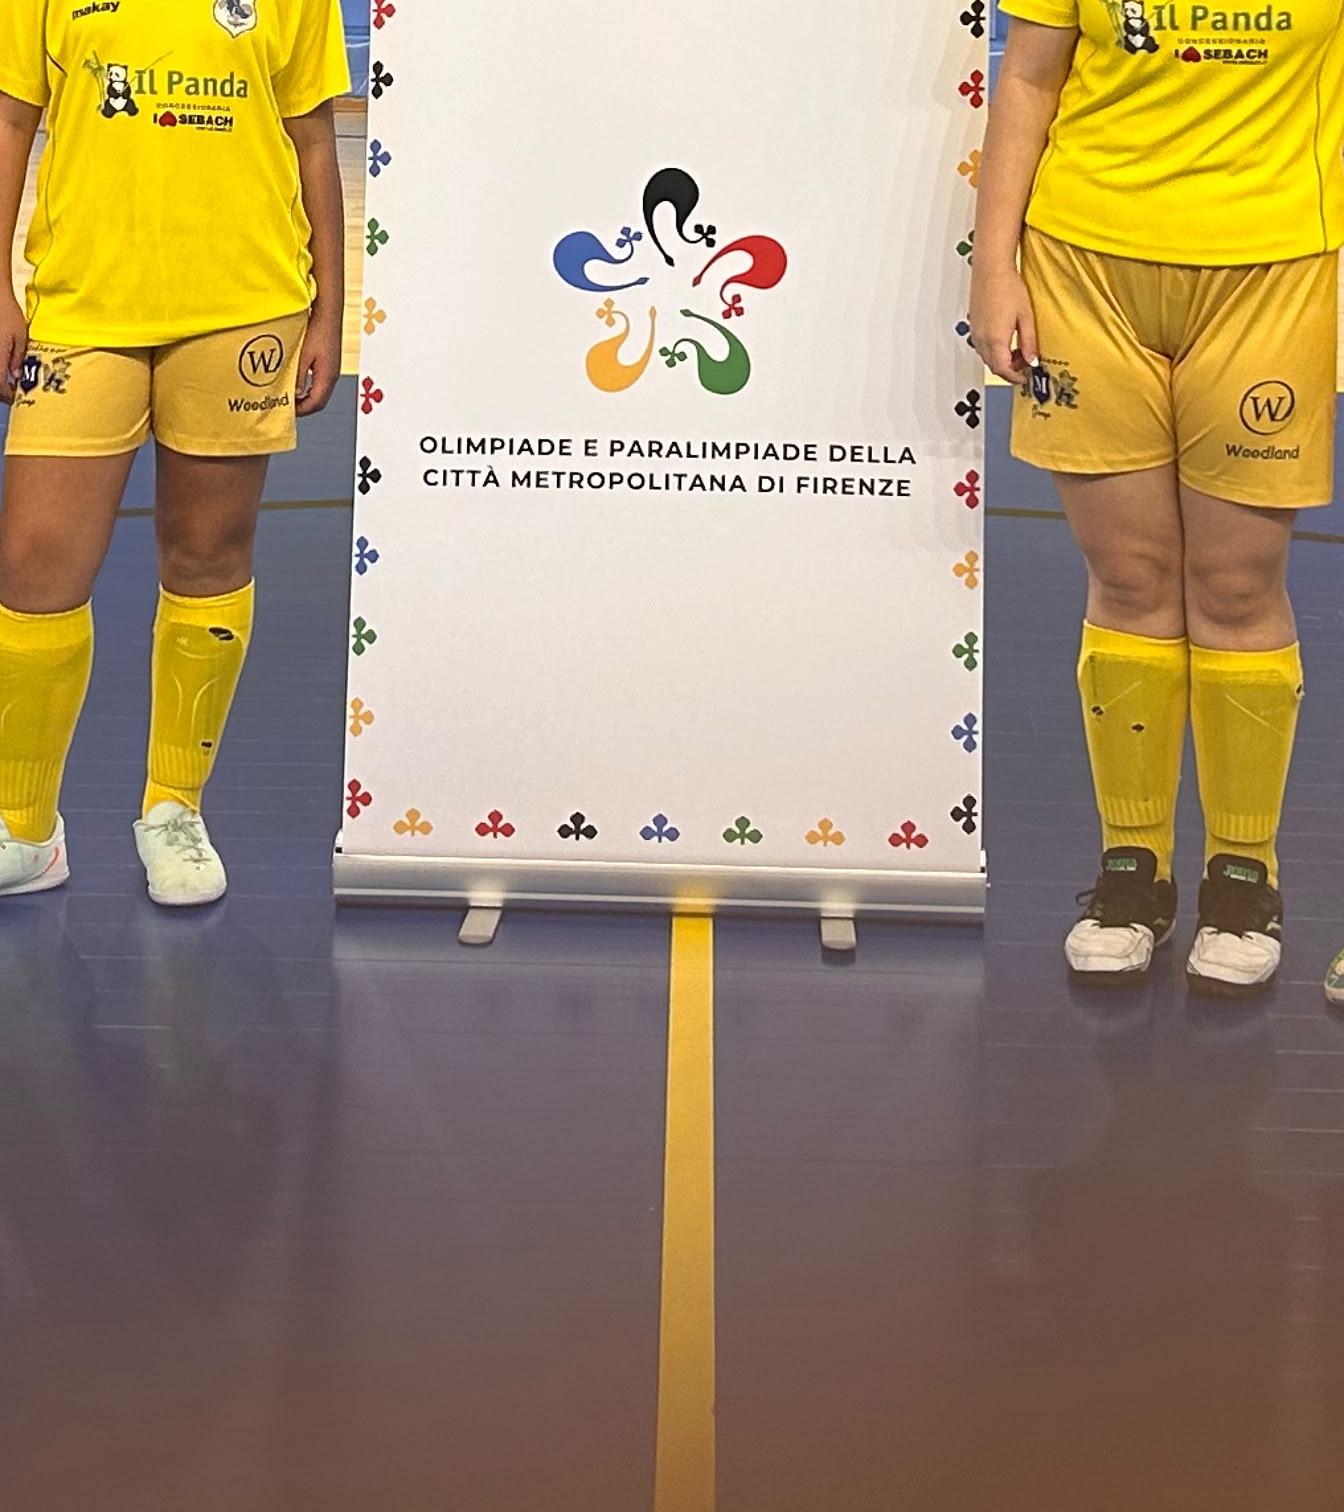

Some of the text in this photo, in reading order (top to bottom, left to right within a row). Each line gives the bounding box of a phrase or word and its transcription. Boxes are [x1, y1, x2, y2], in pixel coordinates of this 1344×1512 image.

[72, 0, 120, 21] makay
[1153, 4, 1292, 32] Il Panda
[1204, 48, 1268, 60] SEBACH
[134, 70, 248, 99] Il Panda
[178, 114, 233, 127] SEBACH
[419, 435, 917, 466] OLIMPIADE E PARALIMPIADE DELLA
[1225, 443, 1300, 460] Woodland
[422, 464, 912, 498] CITTÀ METROPOLITANA DI FIRENZE
